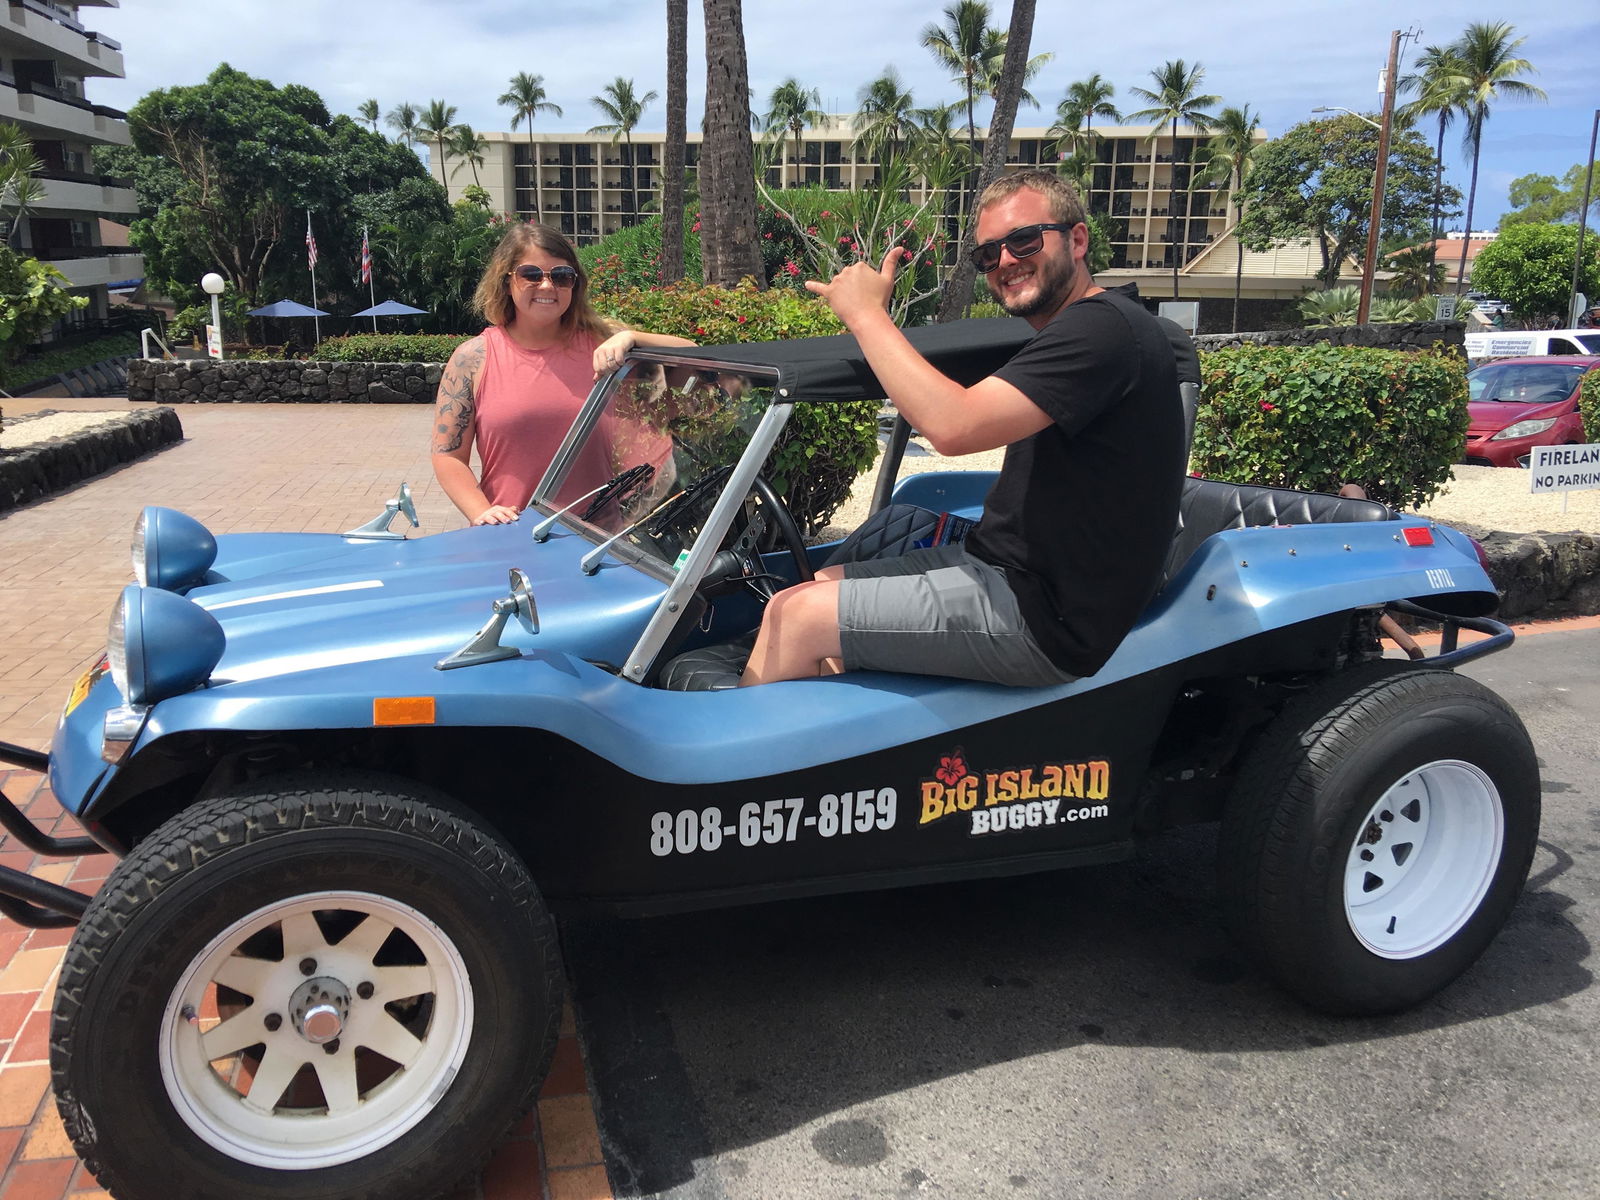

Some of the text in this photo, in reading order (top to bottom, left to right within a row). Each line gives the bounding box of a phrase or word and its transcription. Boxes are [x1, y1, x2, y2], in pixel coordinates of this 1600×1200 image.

[1441, 308, 1451, 317] 15
[1540, 449, 1600, 467] FIRELAN
[1536, 472, 1600, 488] NO PARKIN
[650, 787, 897, 857] 808-657-8159
